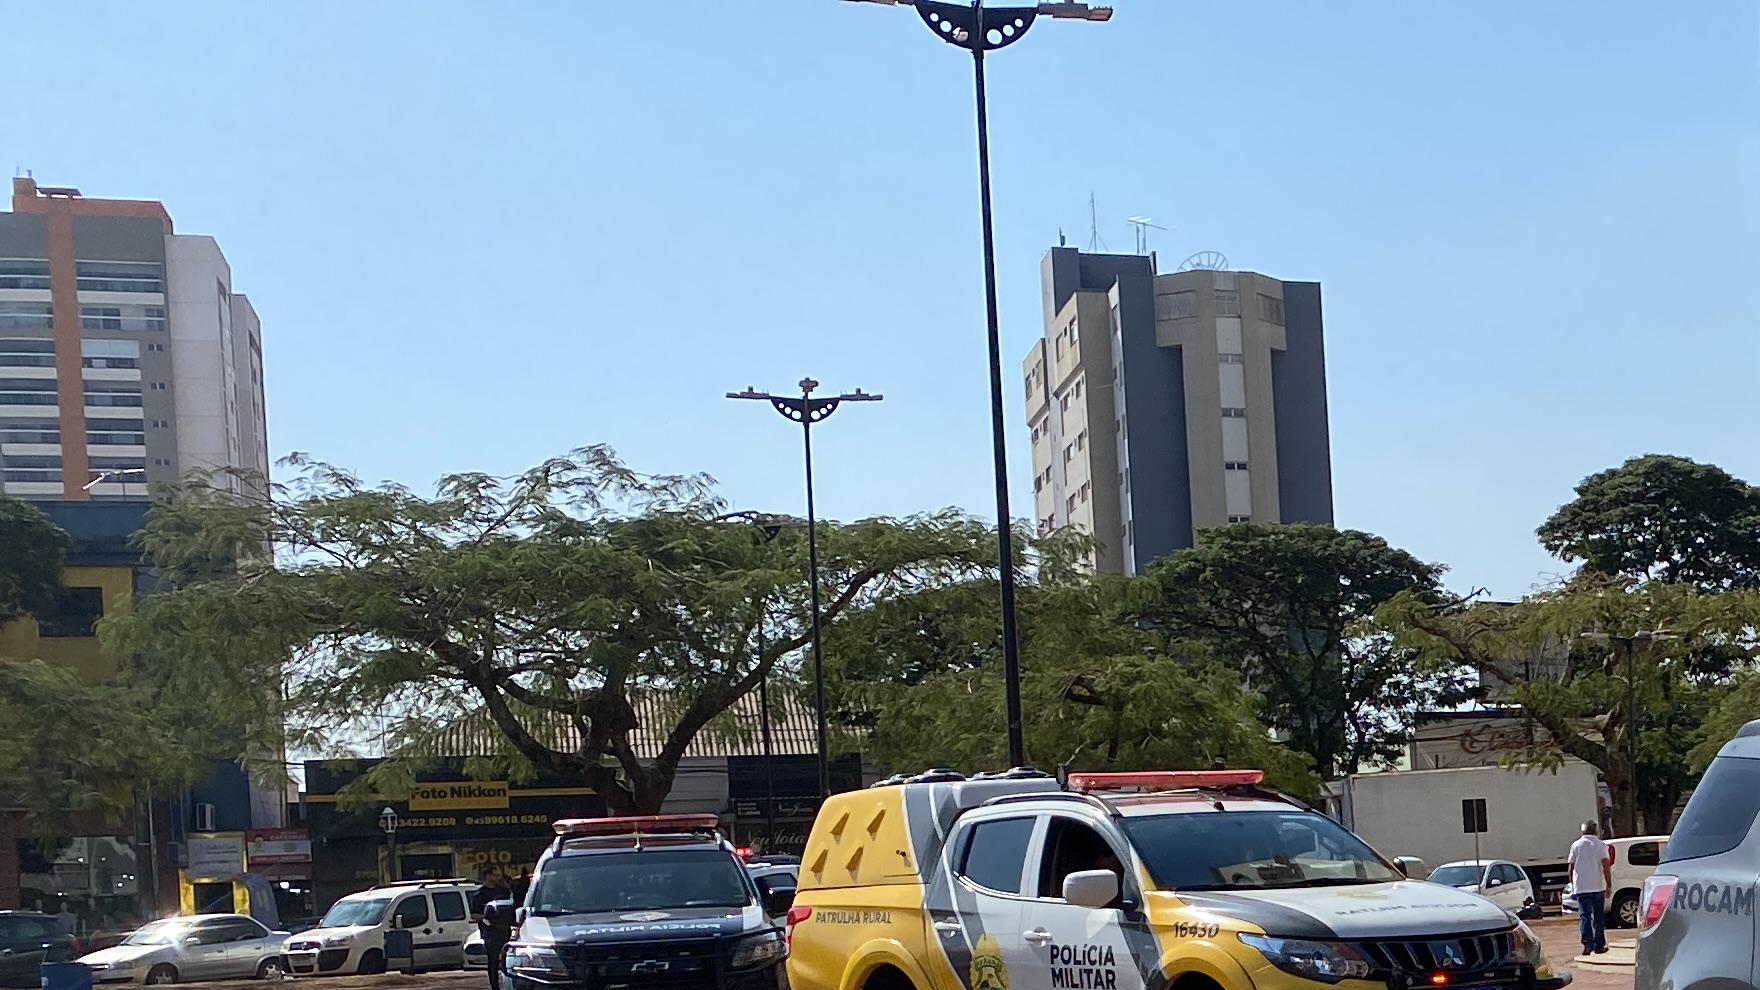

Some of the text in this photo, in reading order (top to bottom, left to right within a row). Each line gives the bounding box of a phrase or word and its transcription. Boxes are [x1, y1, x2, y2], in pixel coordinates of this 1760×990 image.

[450, 785, 507, 799] Nikkon
[1674, 882, 1755, 915] ROCAM
[816, 911, 892, 924] PATRULHA RURAL
[1050, 967, 1117, 990] MILITAR
